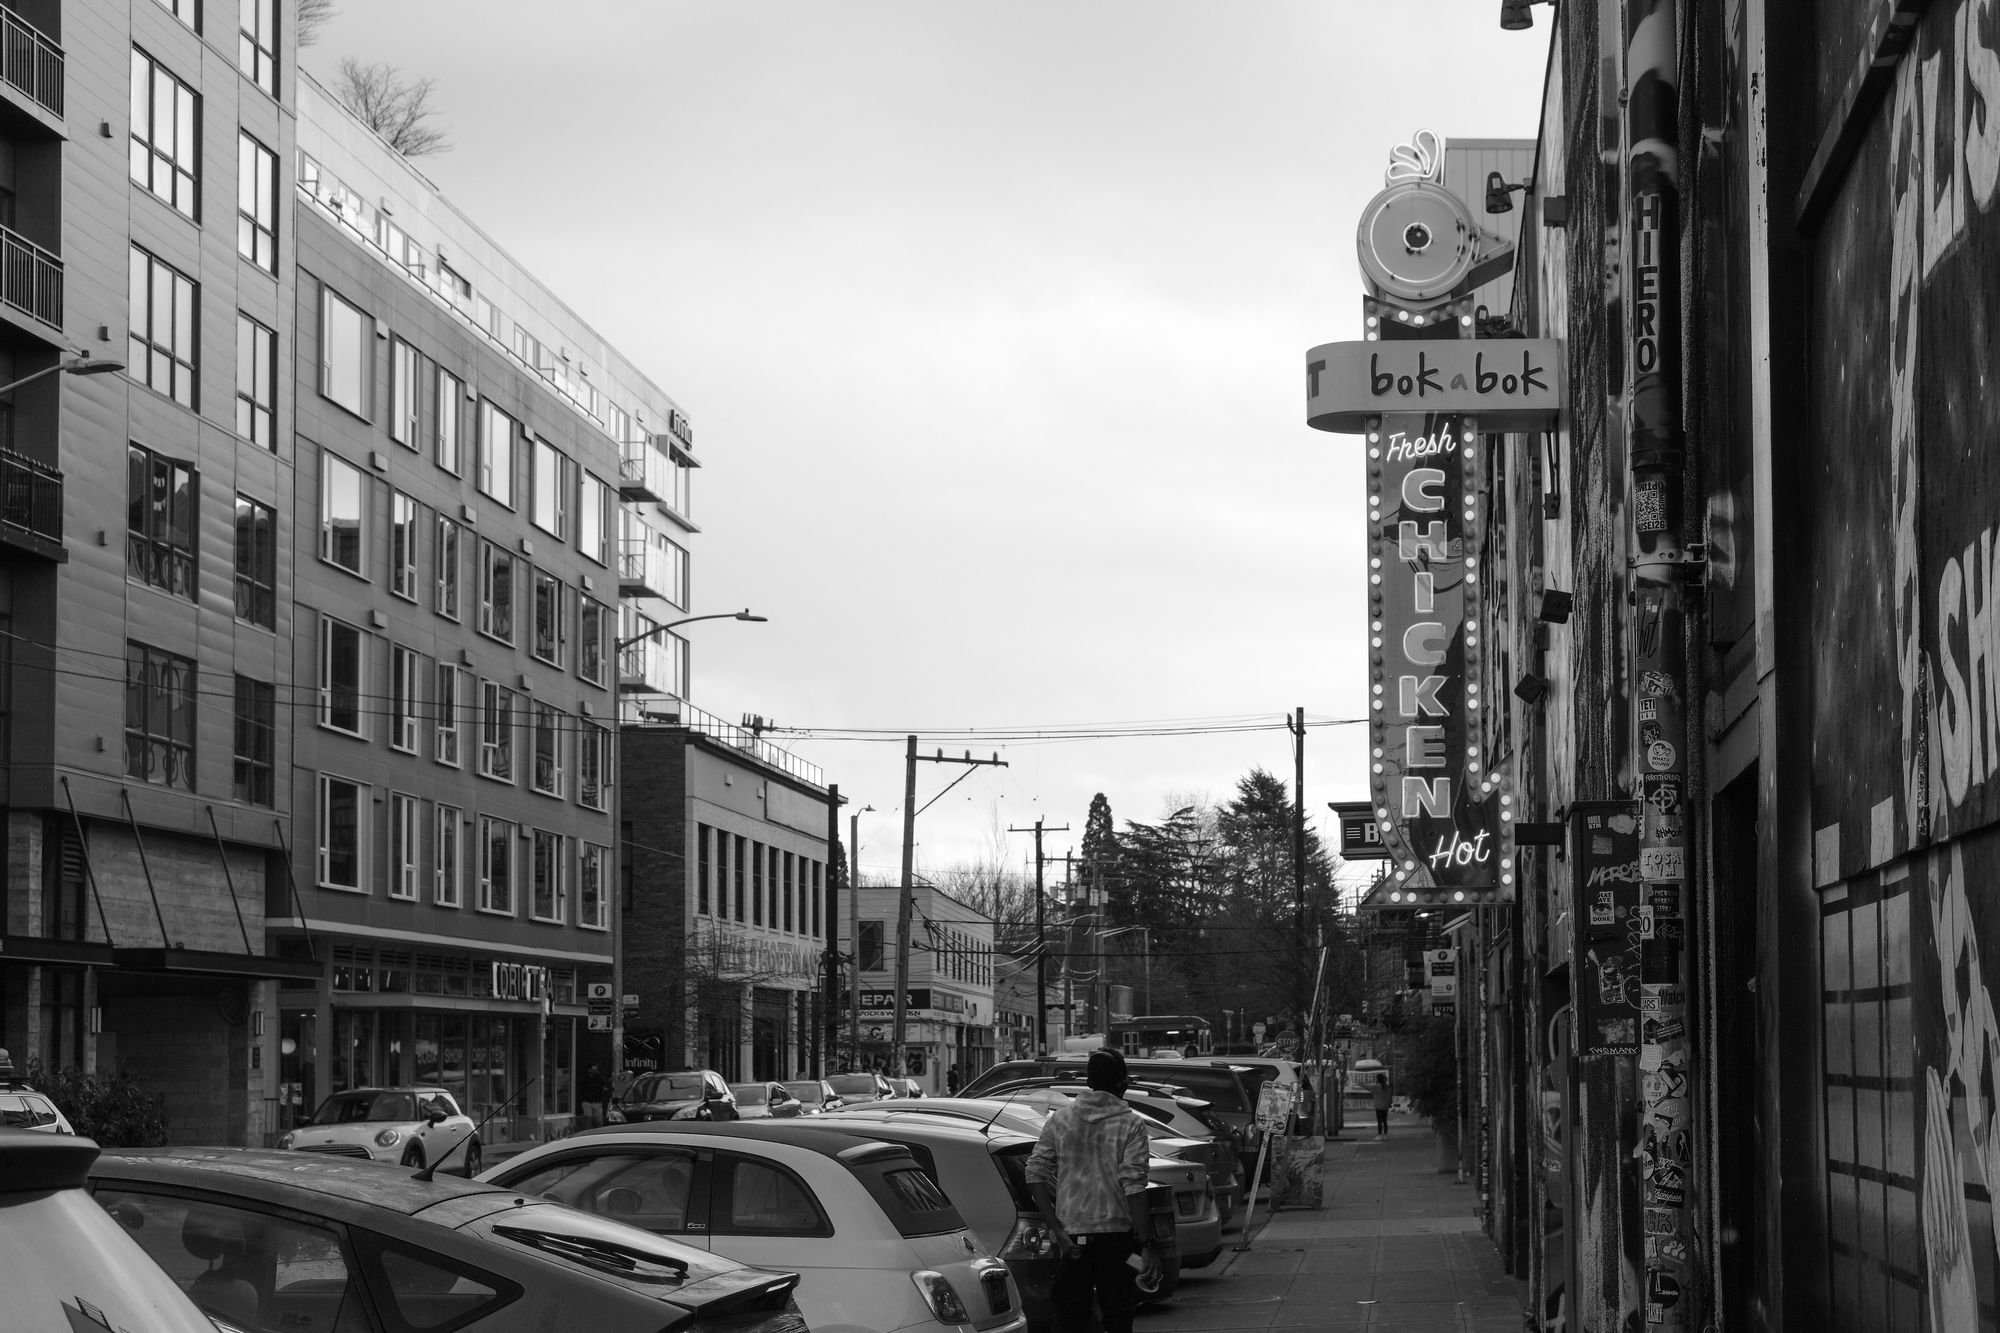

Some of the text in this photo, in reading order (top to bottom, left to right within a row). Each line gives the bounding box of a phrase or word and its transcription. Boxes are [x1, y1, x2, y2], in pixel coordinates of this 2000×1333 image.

[1637, 196, 1660, 372] HIERO
[1370, 350, 1549, 397] bok a bok
[1386, 422, 1457, 463] Fresh
[1399, 468, 1451, 819] CHICKEN
[1364, 822, 1383, 847] B
[1428, 828, 1491, 870] Hot
[530, 968, 554, 1003] TA
[860, 994, 913, 1006] EPAR
[857, 1010, 920, 1018] VOLKSWEN
[1277, 1038, 1297, 1047] STOP
